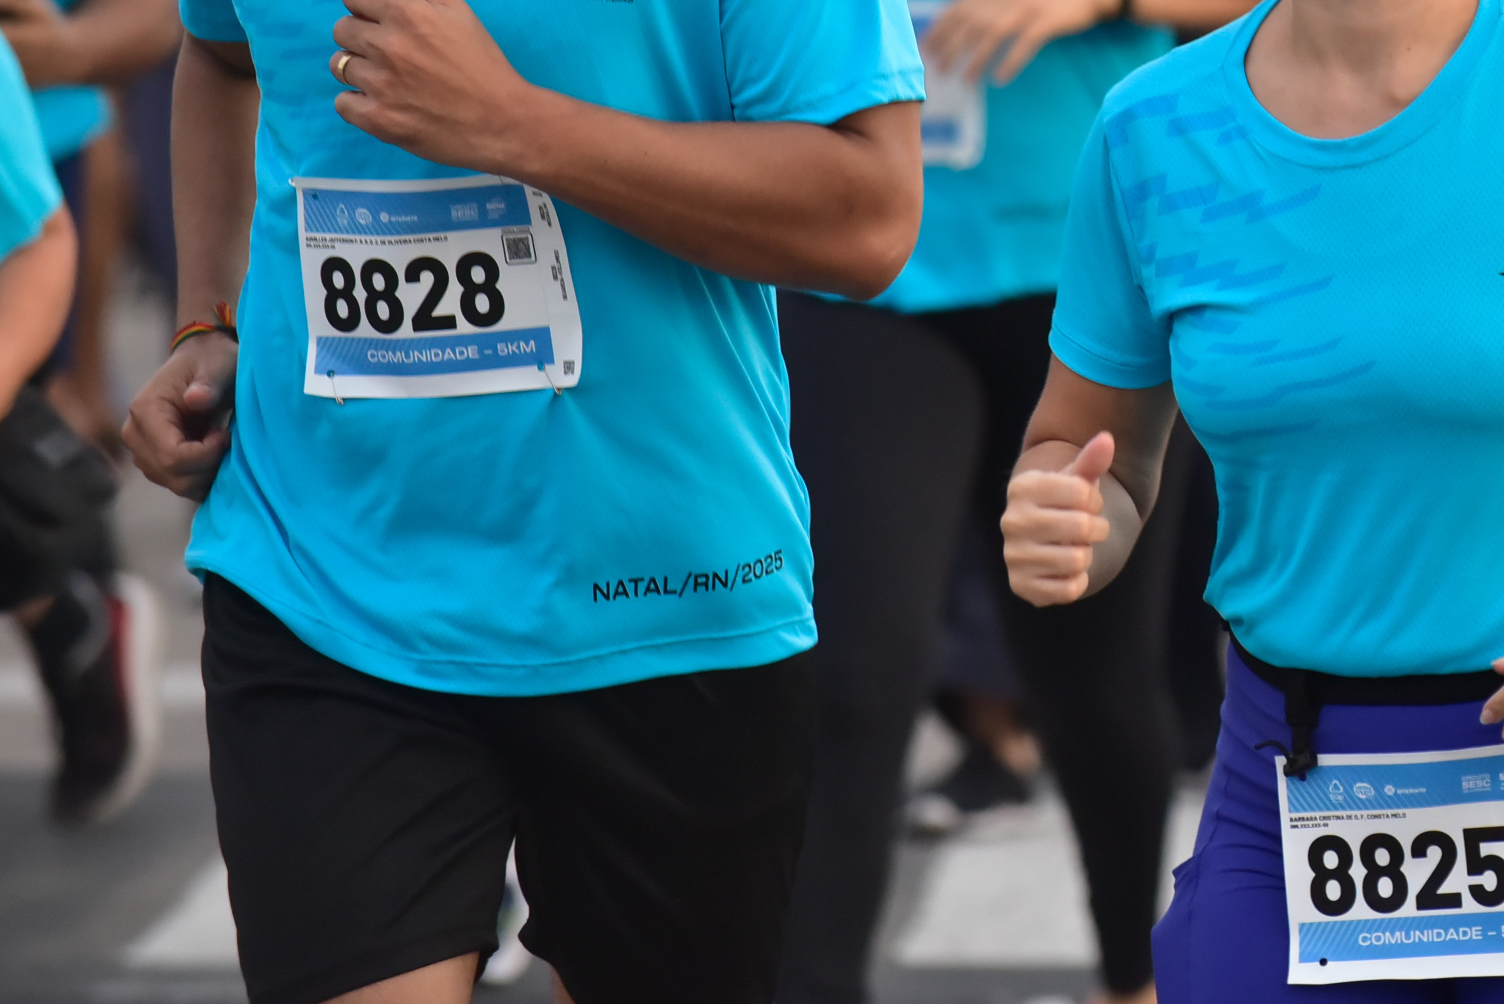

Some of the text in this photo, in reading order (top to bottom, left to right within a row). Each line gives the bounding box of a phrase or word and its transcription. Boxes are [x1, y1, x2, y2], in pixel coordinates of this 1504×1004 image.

[320, 251, 505, 335] 8828
[367, 344, 480, 364] COMUNIDADE
[497, 339, 537, 355] 5KM
[592, 549, 784, 603] NATAL/RN/2025
[1462, 778, 1491, 789] SESC
[1319, 814, 1345, 822] CRISTINA
[1358, 926, 1483, 946] COMUNIDADE
